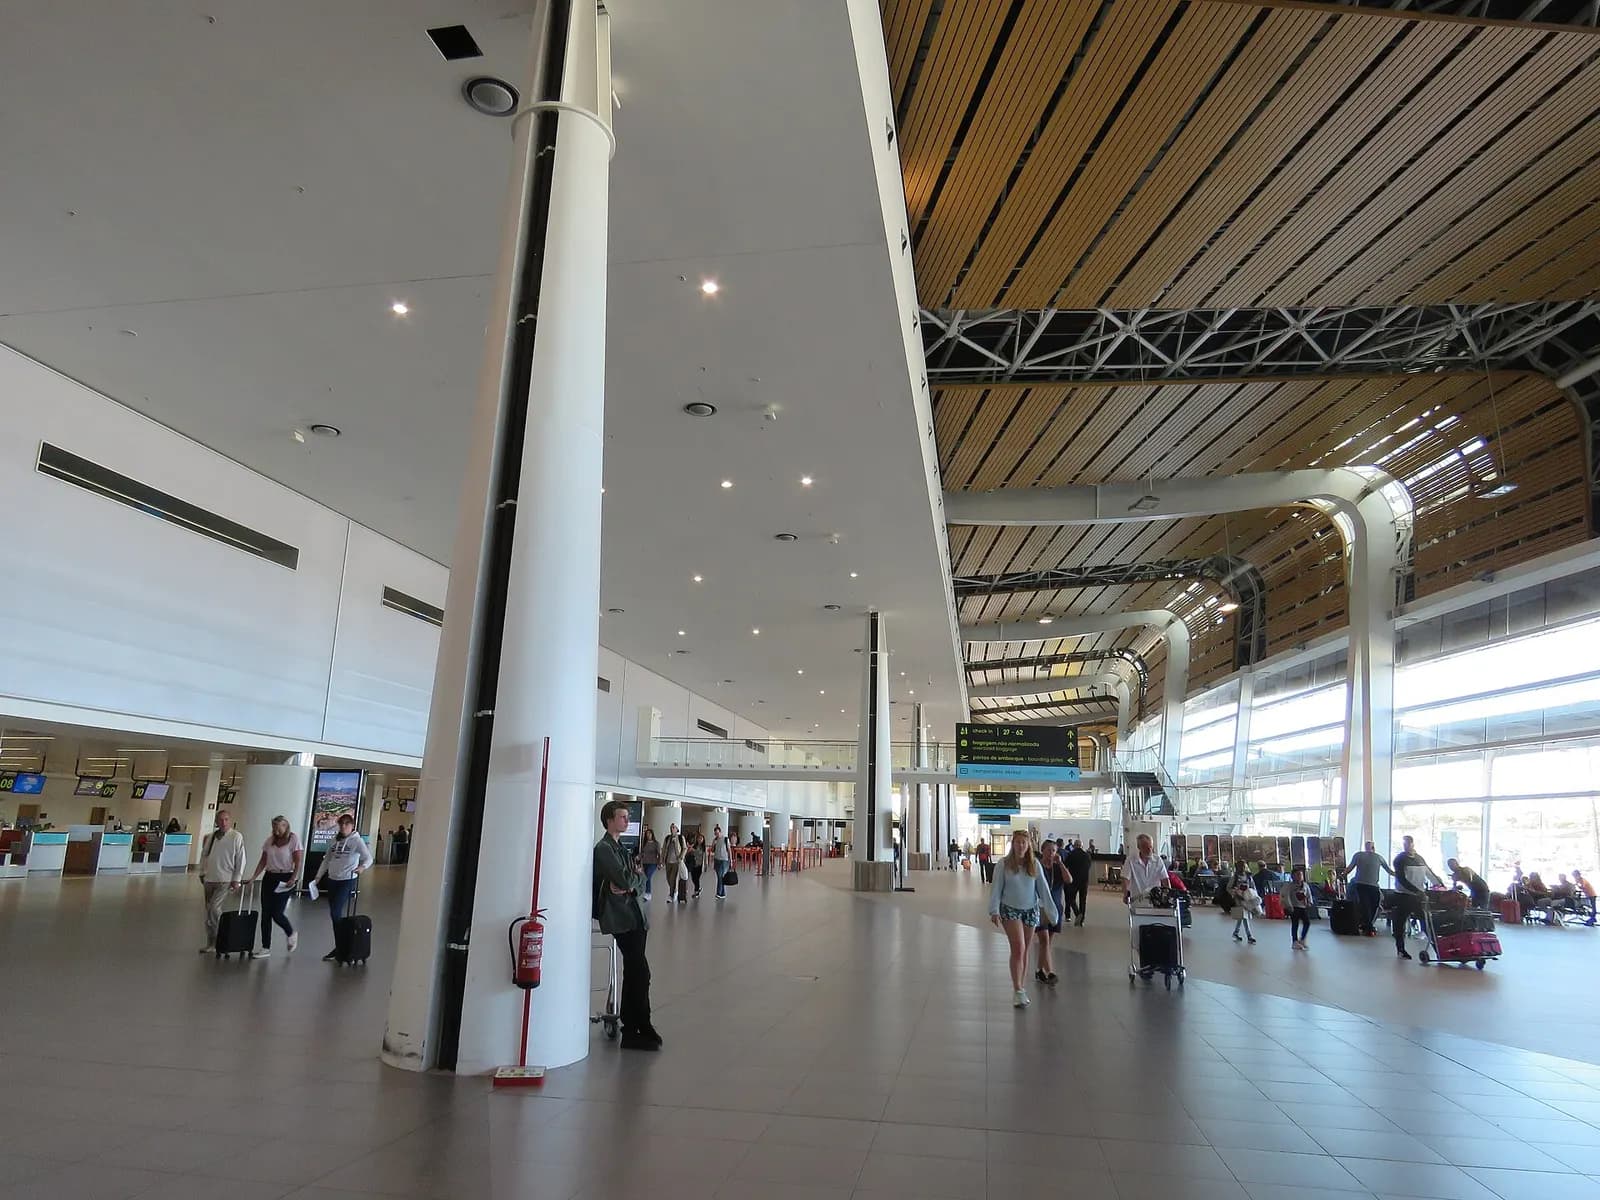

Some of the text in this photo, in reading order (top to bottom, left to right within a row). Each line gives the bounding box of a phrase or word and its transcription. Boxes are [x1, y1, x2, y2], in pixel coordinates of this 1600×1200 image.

[1002, 728, 1010, 736] 27
[0, 778, 14, 789] 08
[103, 786, 116, 795] 09
[135, 787, 145, 797] 10
